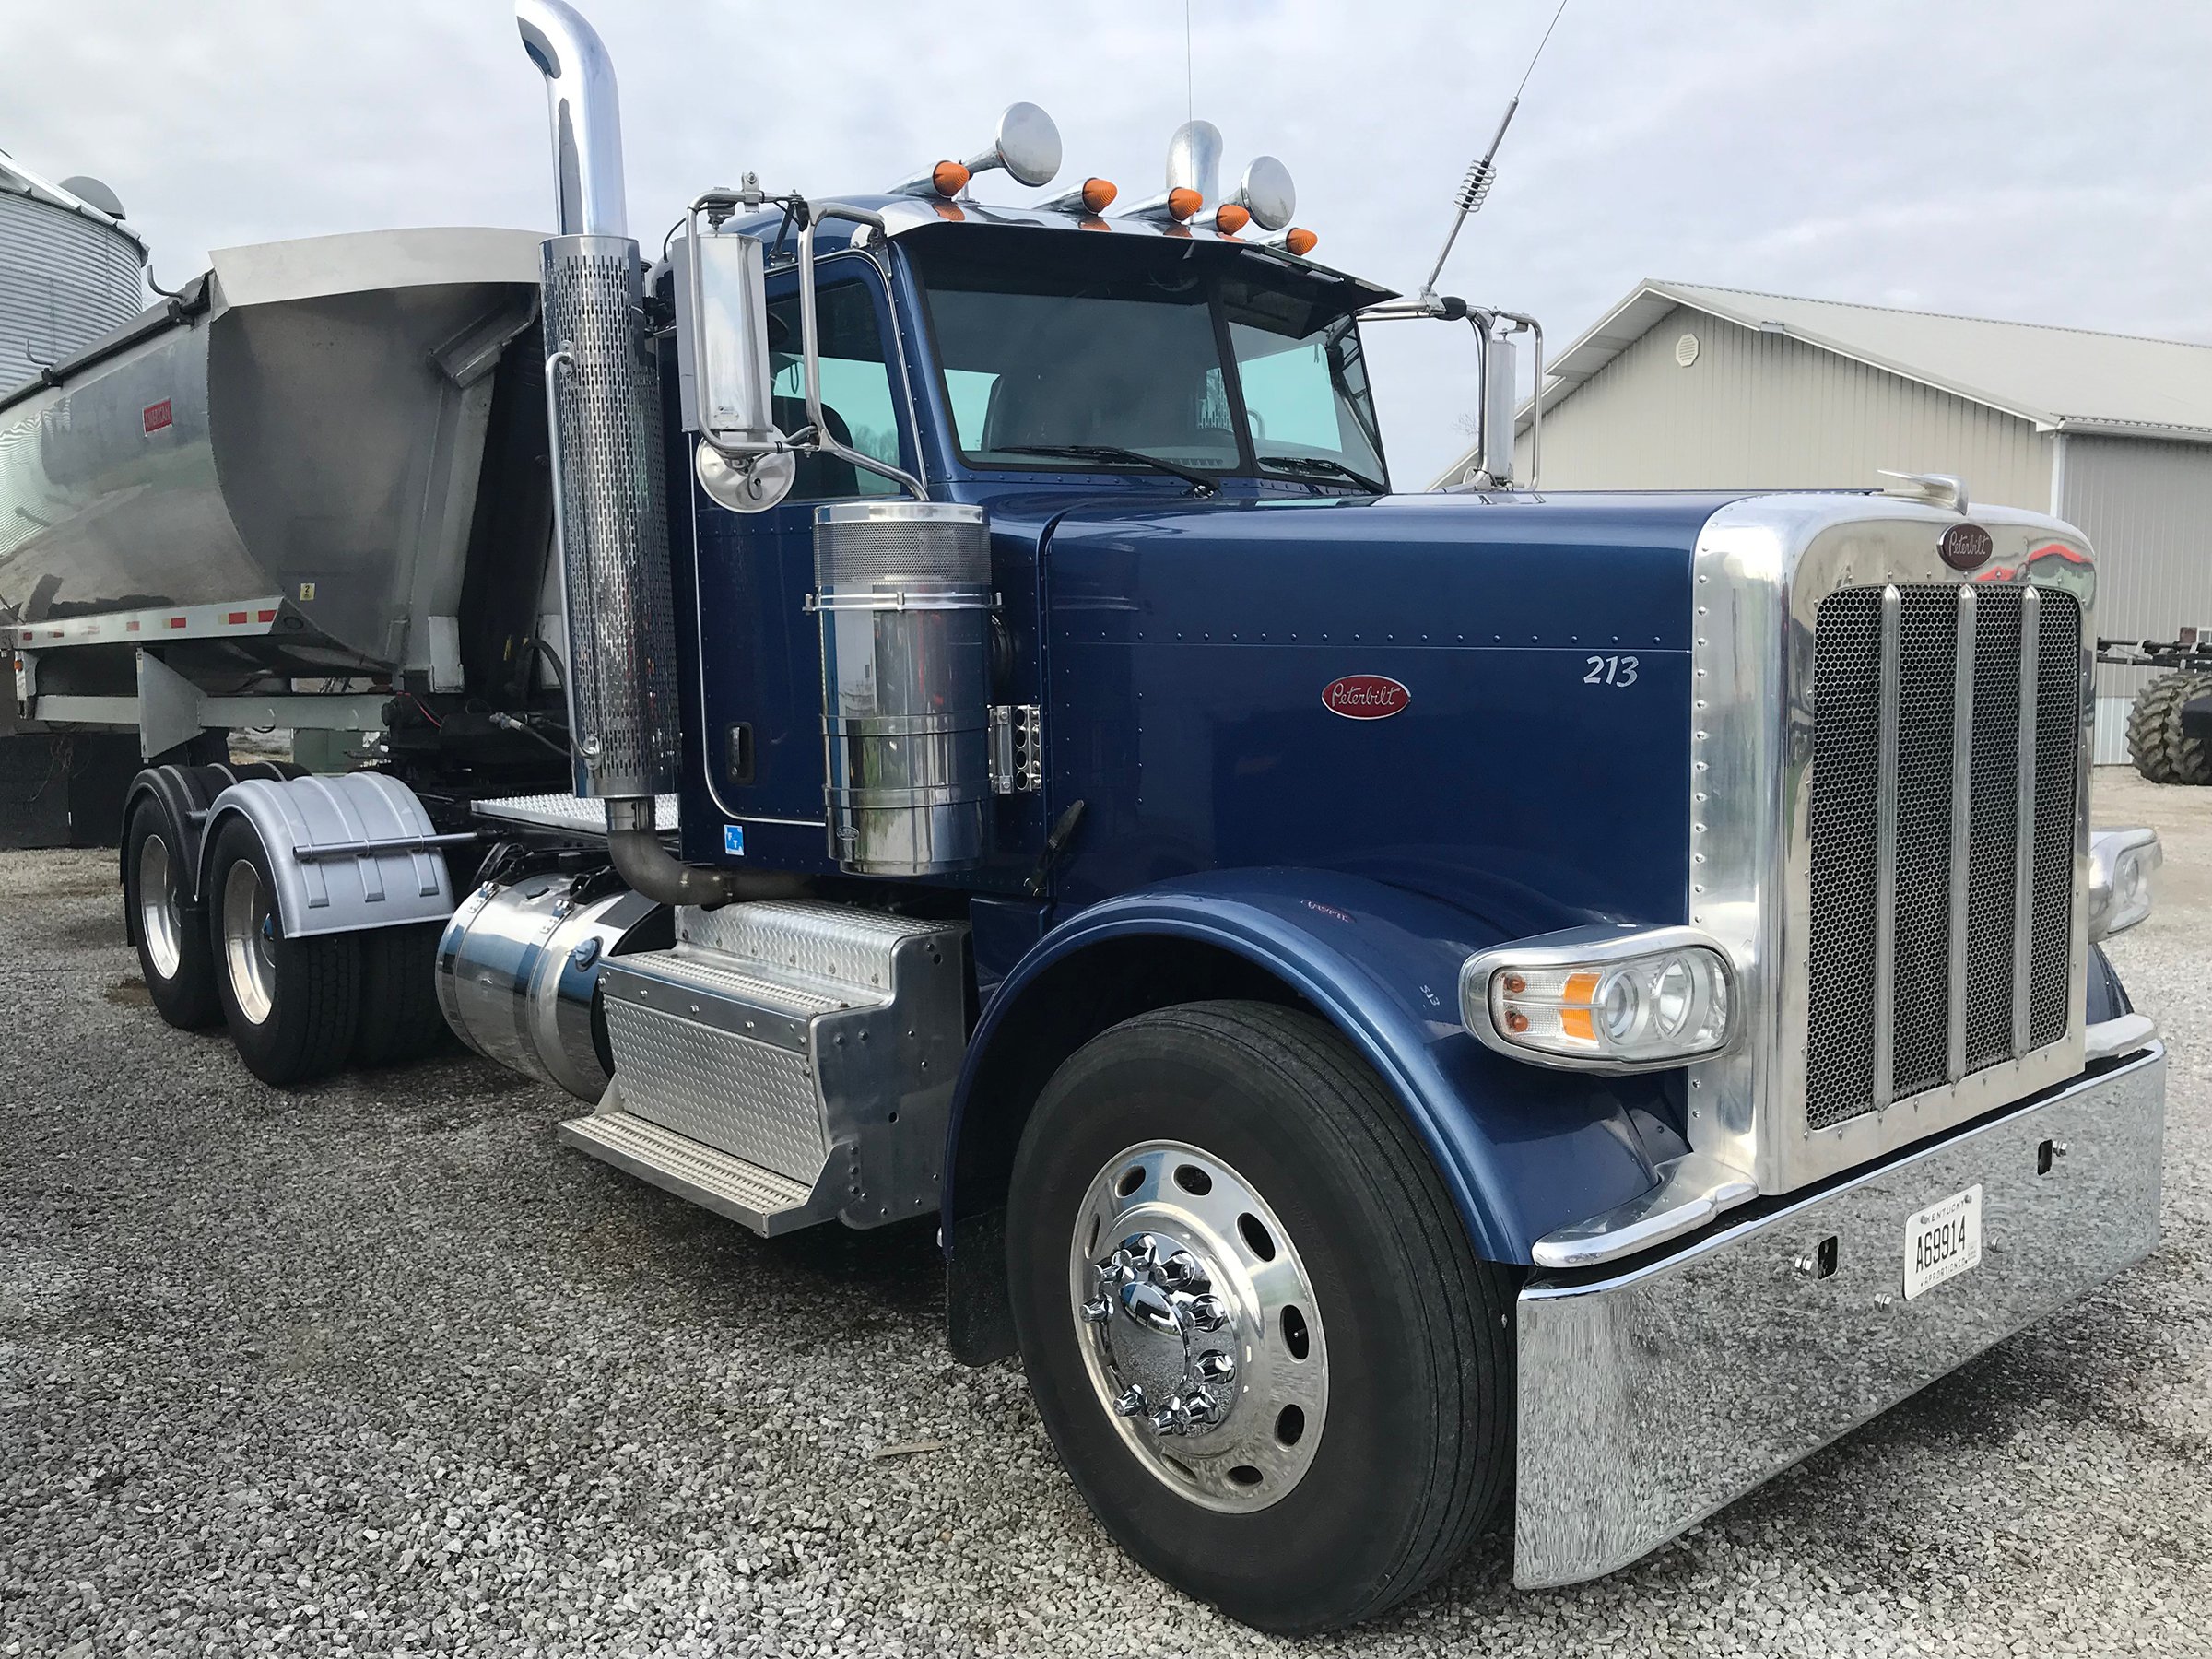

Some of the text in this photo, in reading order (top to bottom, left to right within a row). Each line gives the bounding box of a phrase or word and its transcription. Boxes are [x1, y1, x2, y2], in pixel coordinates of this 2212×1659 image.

[1949, 530, 1989, 557] Peterbilt
[1583, 655, 1639, 688] 213
[1332, 683, 1401, 707] Peterbilt
[1915, 1215, 1966, 1274] A69914
